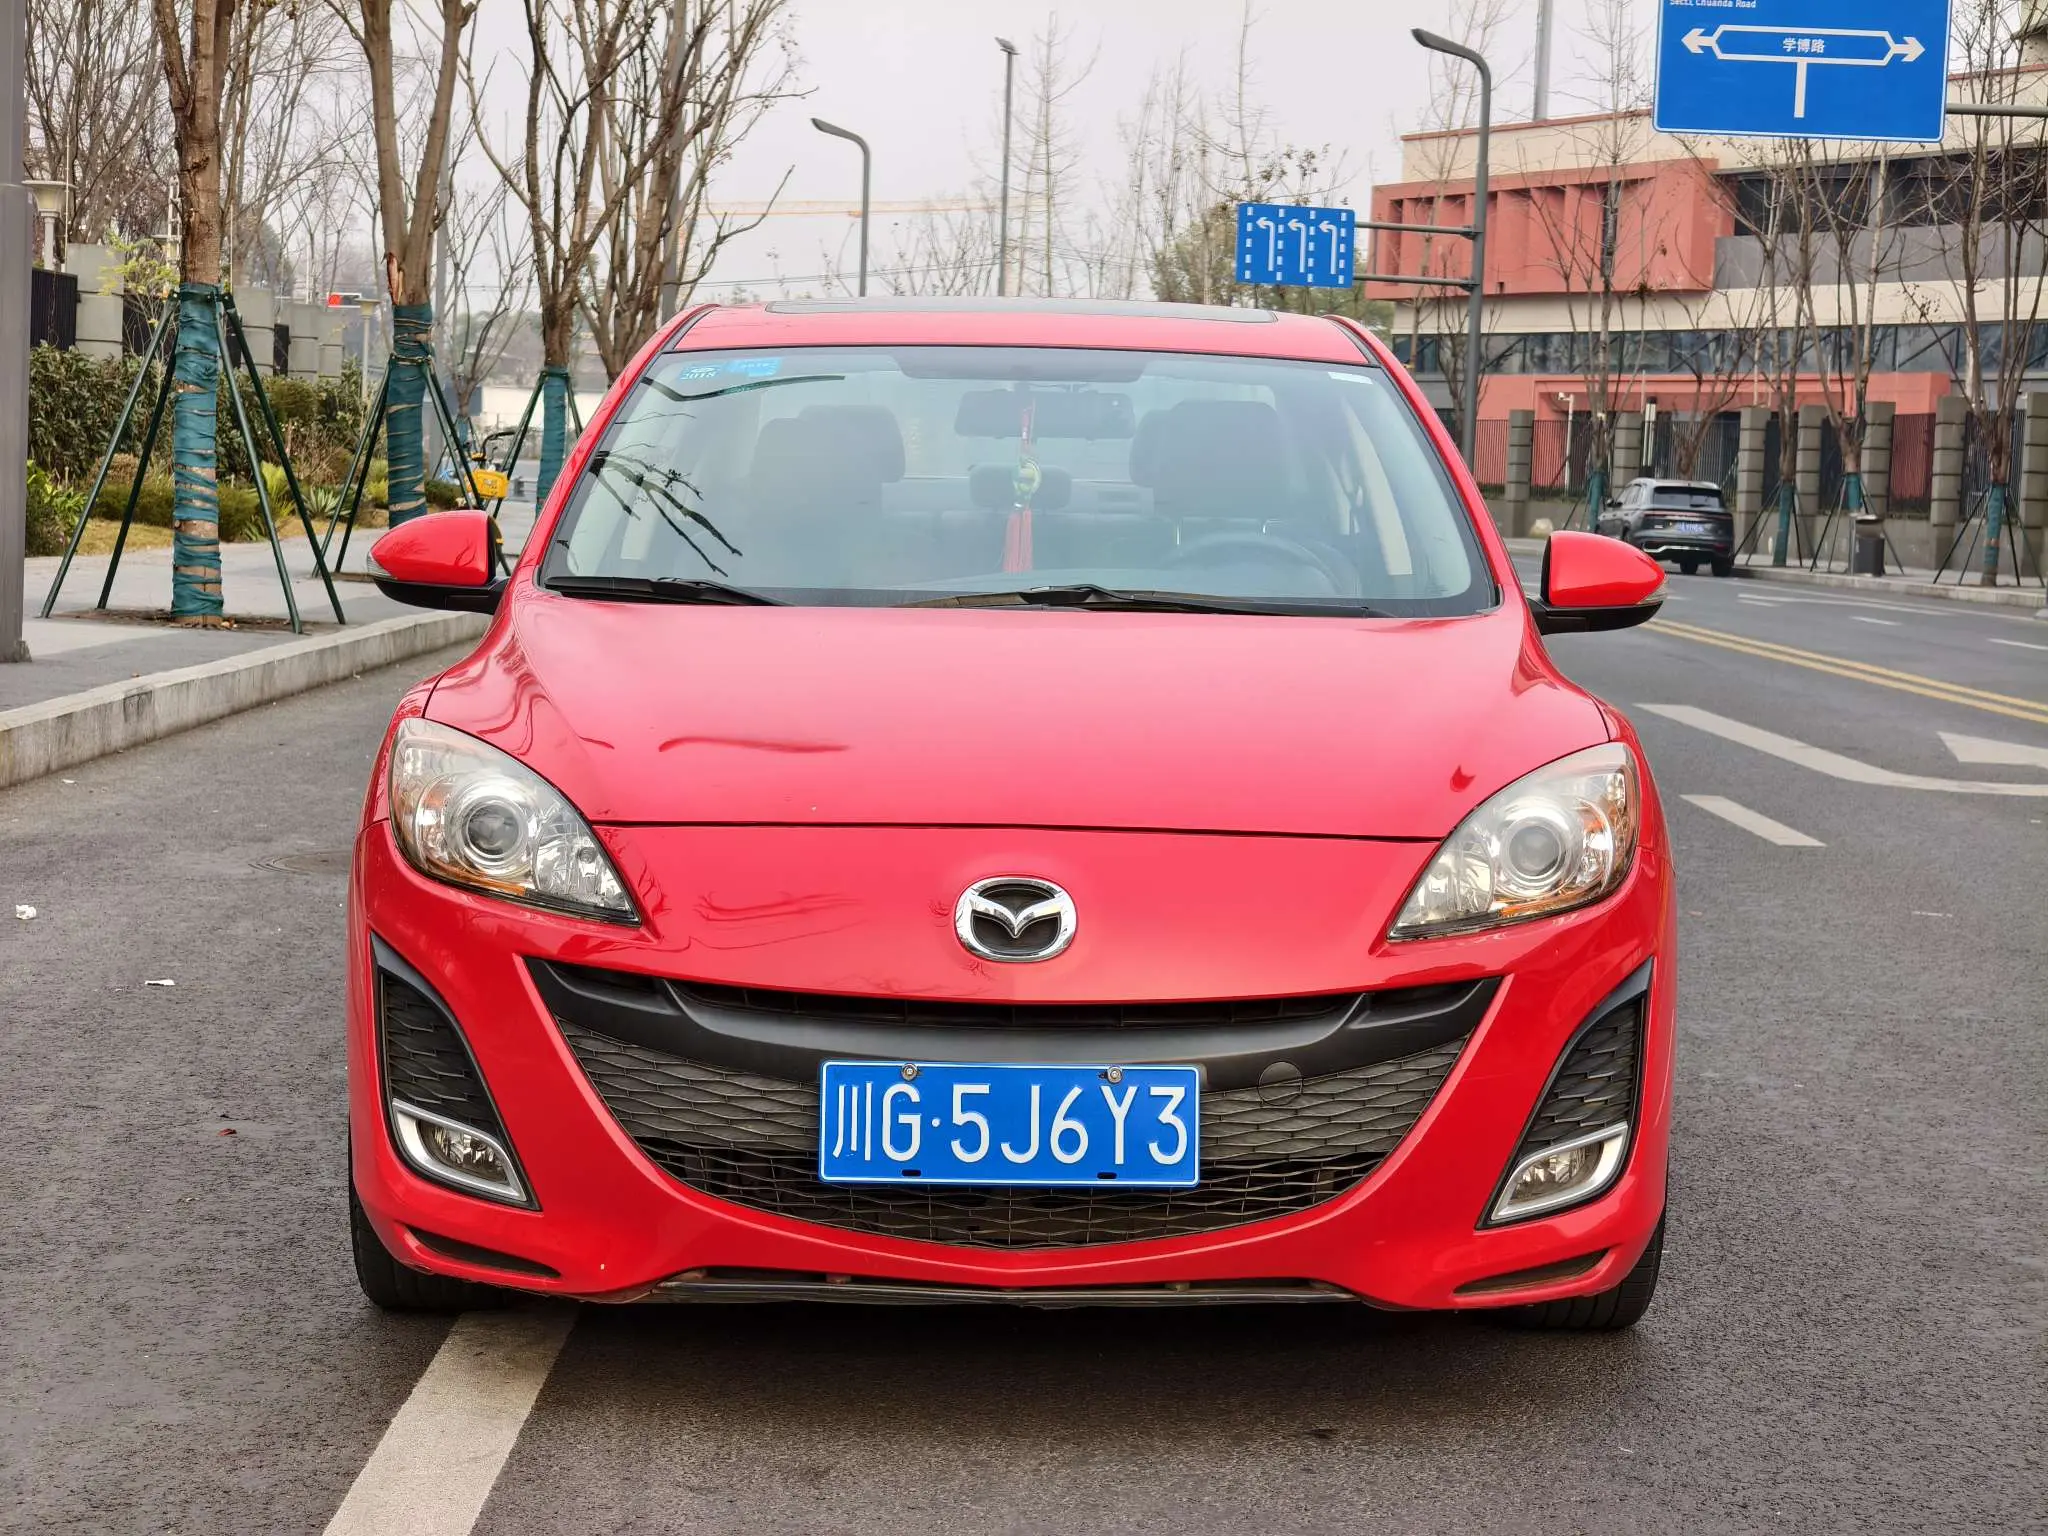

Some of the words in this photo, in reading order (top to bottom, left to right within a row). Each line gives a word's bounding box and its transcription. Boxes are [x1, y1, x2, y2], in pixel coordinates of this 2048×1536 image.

[1735, 0, 1757, 8] Road
[1783, 37, 1826, 53] 学博路
[833, 1081, 1188, 1165] 川G·5J6Y3
